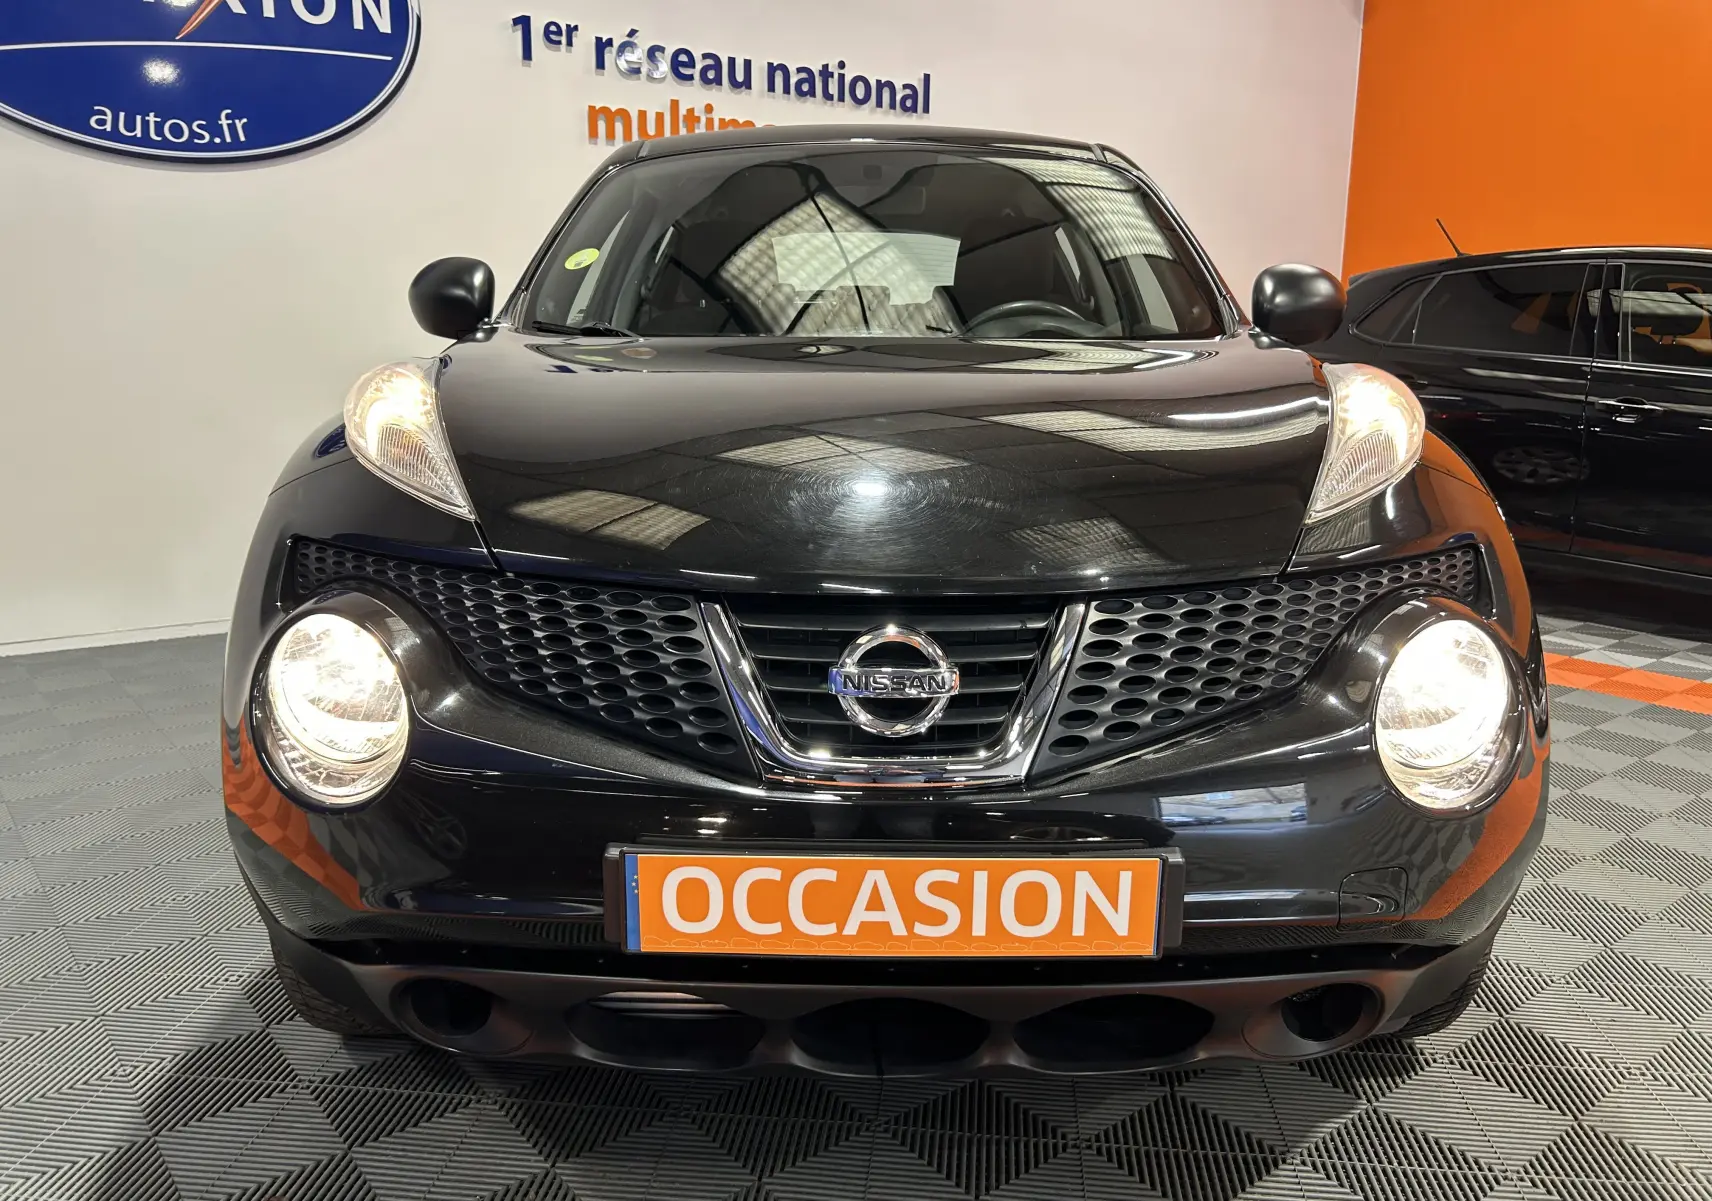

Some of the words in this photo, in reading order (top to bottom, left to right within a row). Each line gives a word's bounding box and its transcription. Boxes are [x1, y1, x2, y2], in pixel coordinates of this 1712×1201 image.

[594, 29, 752, 91] réseau
[767, 60, 931, 115] national
[89, 105, 248, 144] autos.fr
[842, 675, 946, 691] NISSAN
[661, 866, 1133, 937] OCCASION
